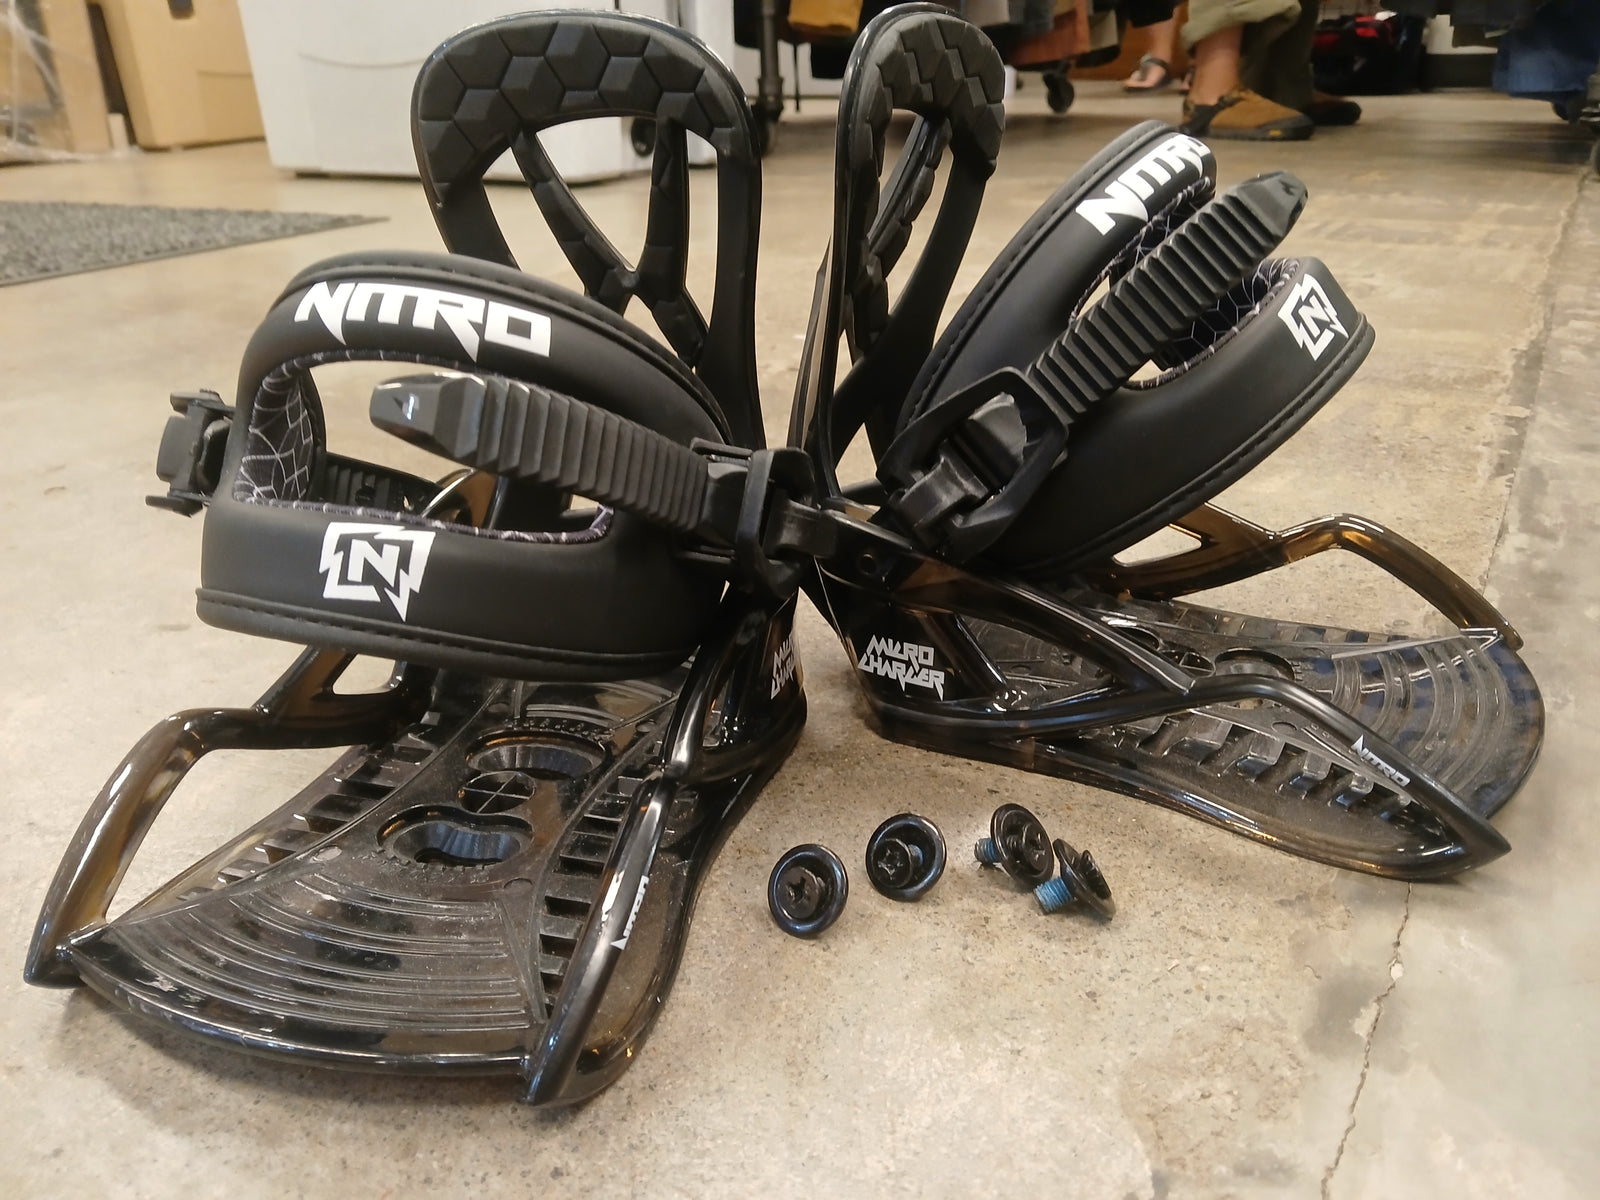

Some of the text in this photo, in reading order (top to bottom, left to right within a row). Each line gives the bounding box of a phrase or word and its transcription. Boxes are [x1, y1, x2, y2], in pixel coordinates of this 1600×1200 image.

[1075, 133, 1212, 236] NITRO
[294, 281, 552, 363] NITRO
[857, 652, 945, 702] CHARGER
[866, 634, 934, 674] MICRO
[1350, 734, 1410, 787] NITRO
